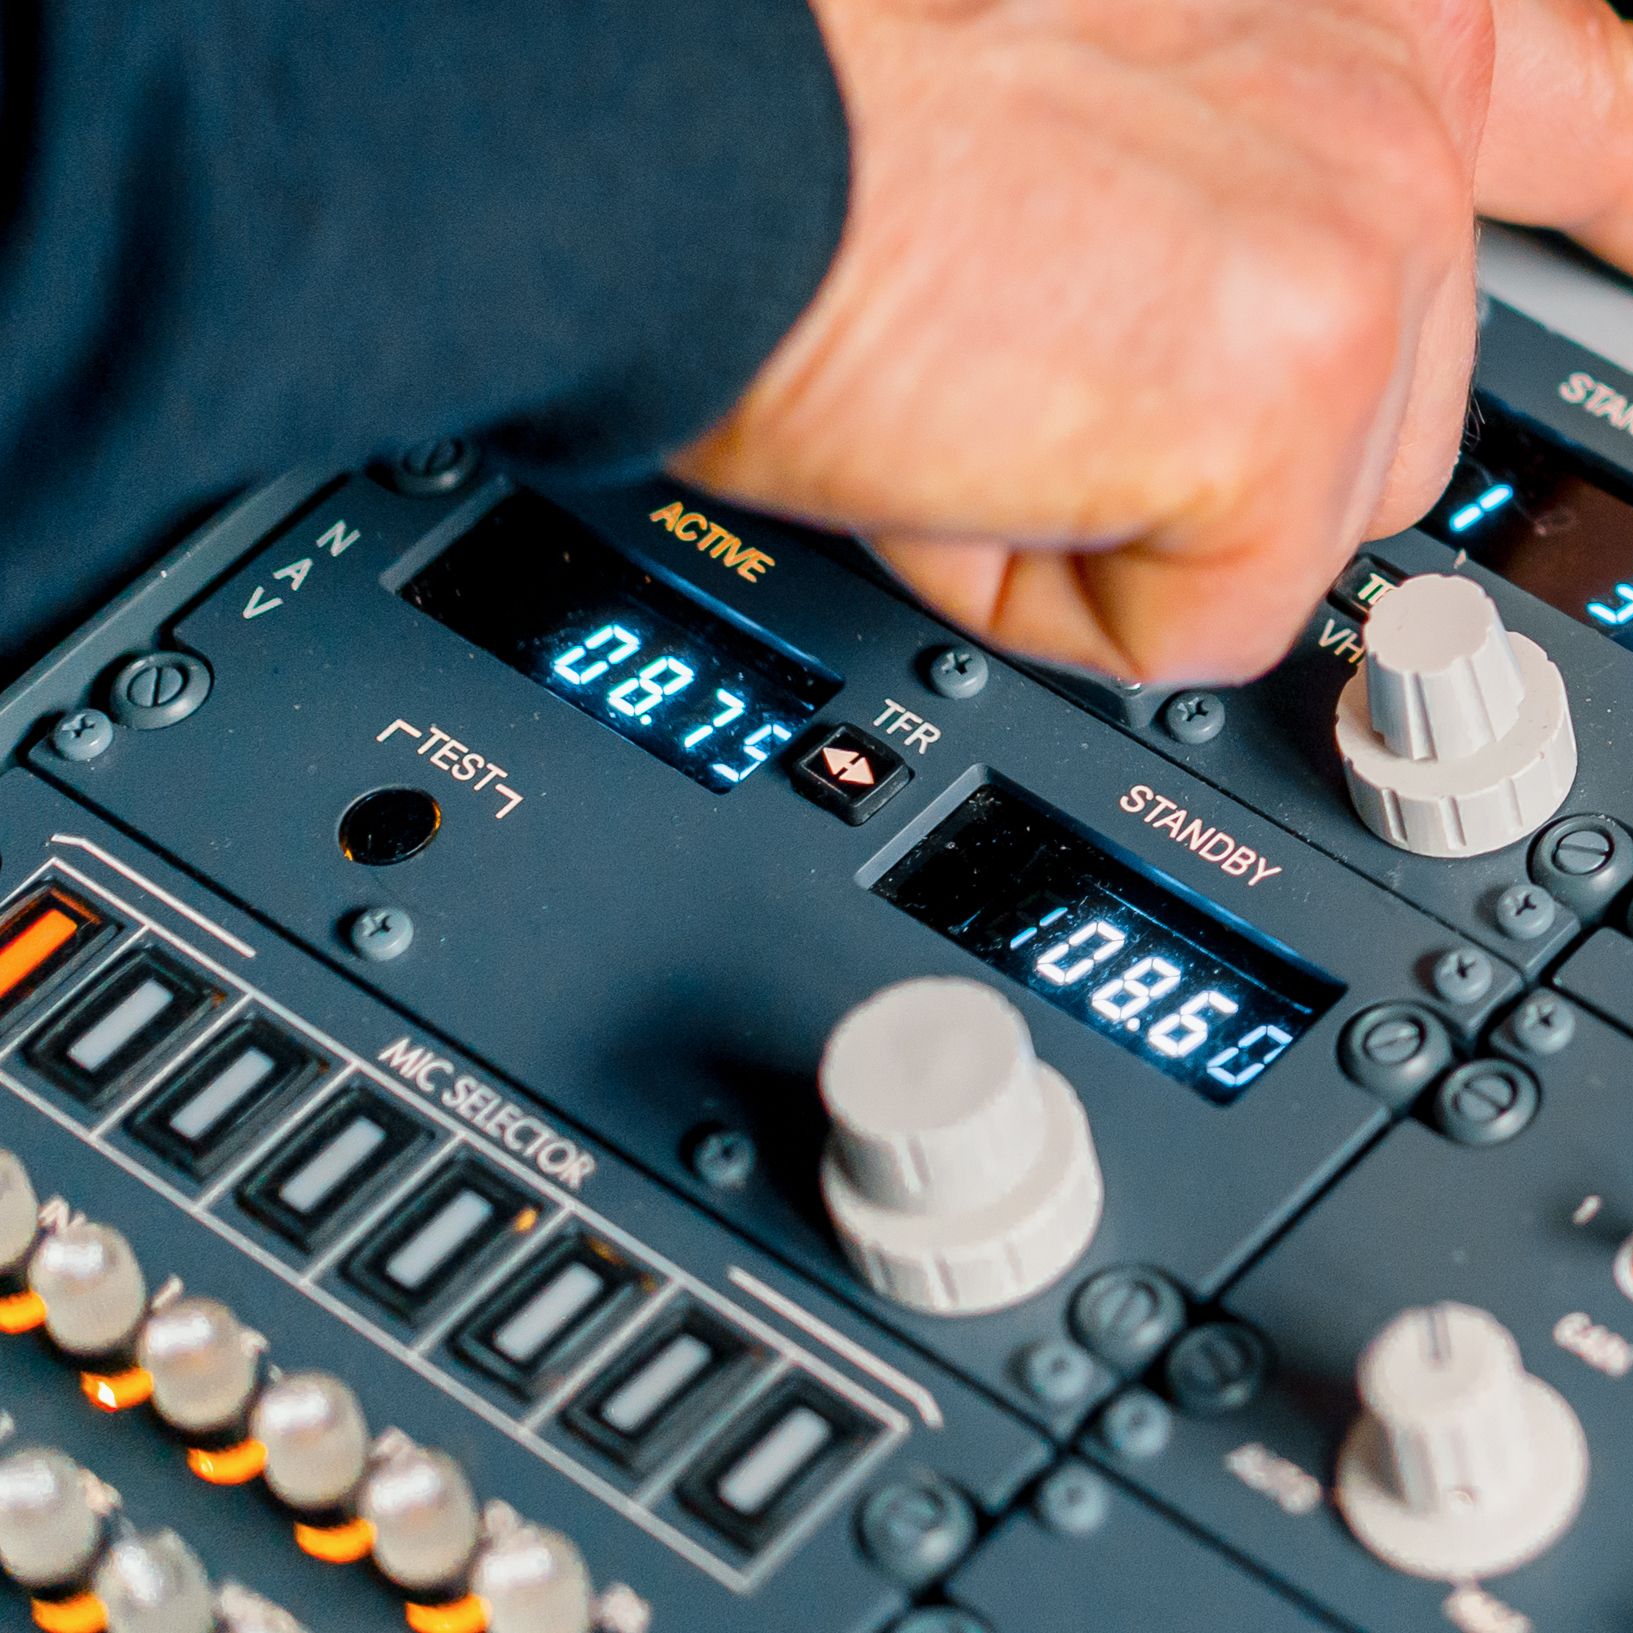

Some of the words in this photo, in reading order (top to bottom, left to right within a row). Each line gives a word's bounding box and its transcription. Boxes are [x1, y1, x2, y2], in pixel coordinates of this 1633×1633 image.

[649, 501, 776, 583] ACTIVE
[1317, 618, 1365, 664] VH
[418, 727, 503, 792] TEST
[871, 698, 942, 756] TFR
[1118, 785, 1283, 887] STANDBY
[379, 1037, 443, 1090] MIC
[440, 1074, 597, 1190] SELECTOR
